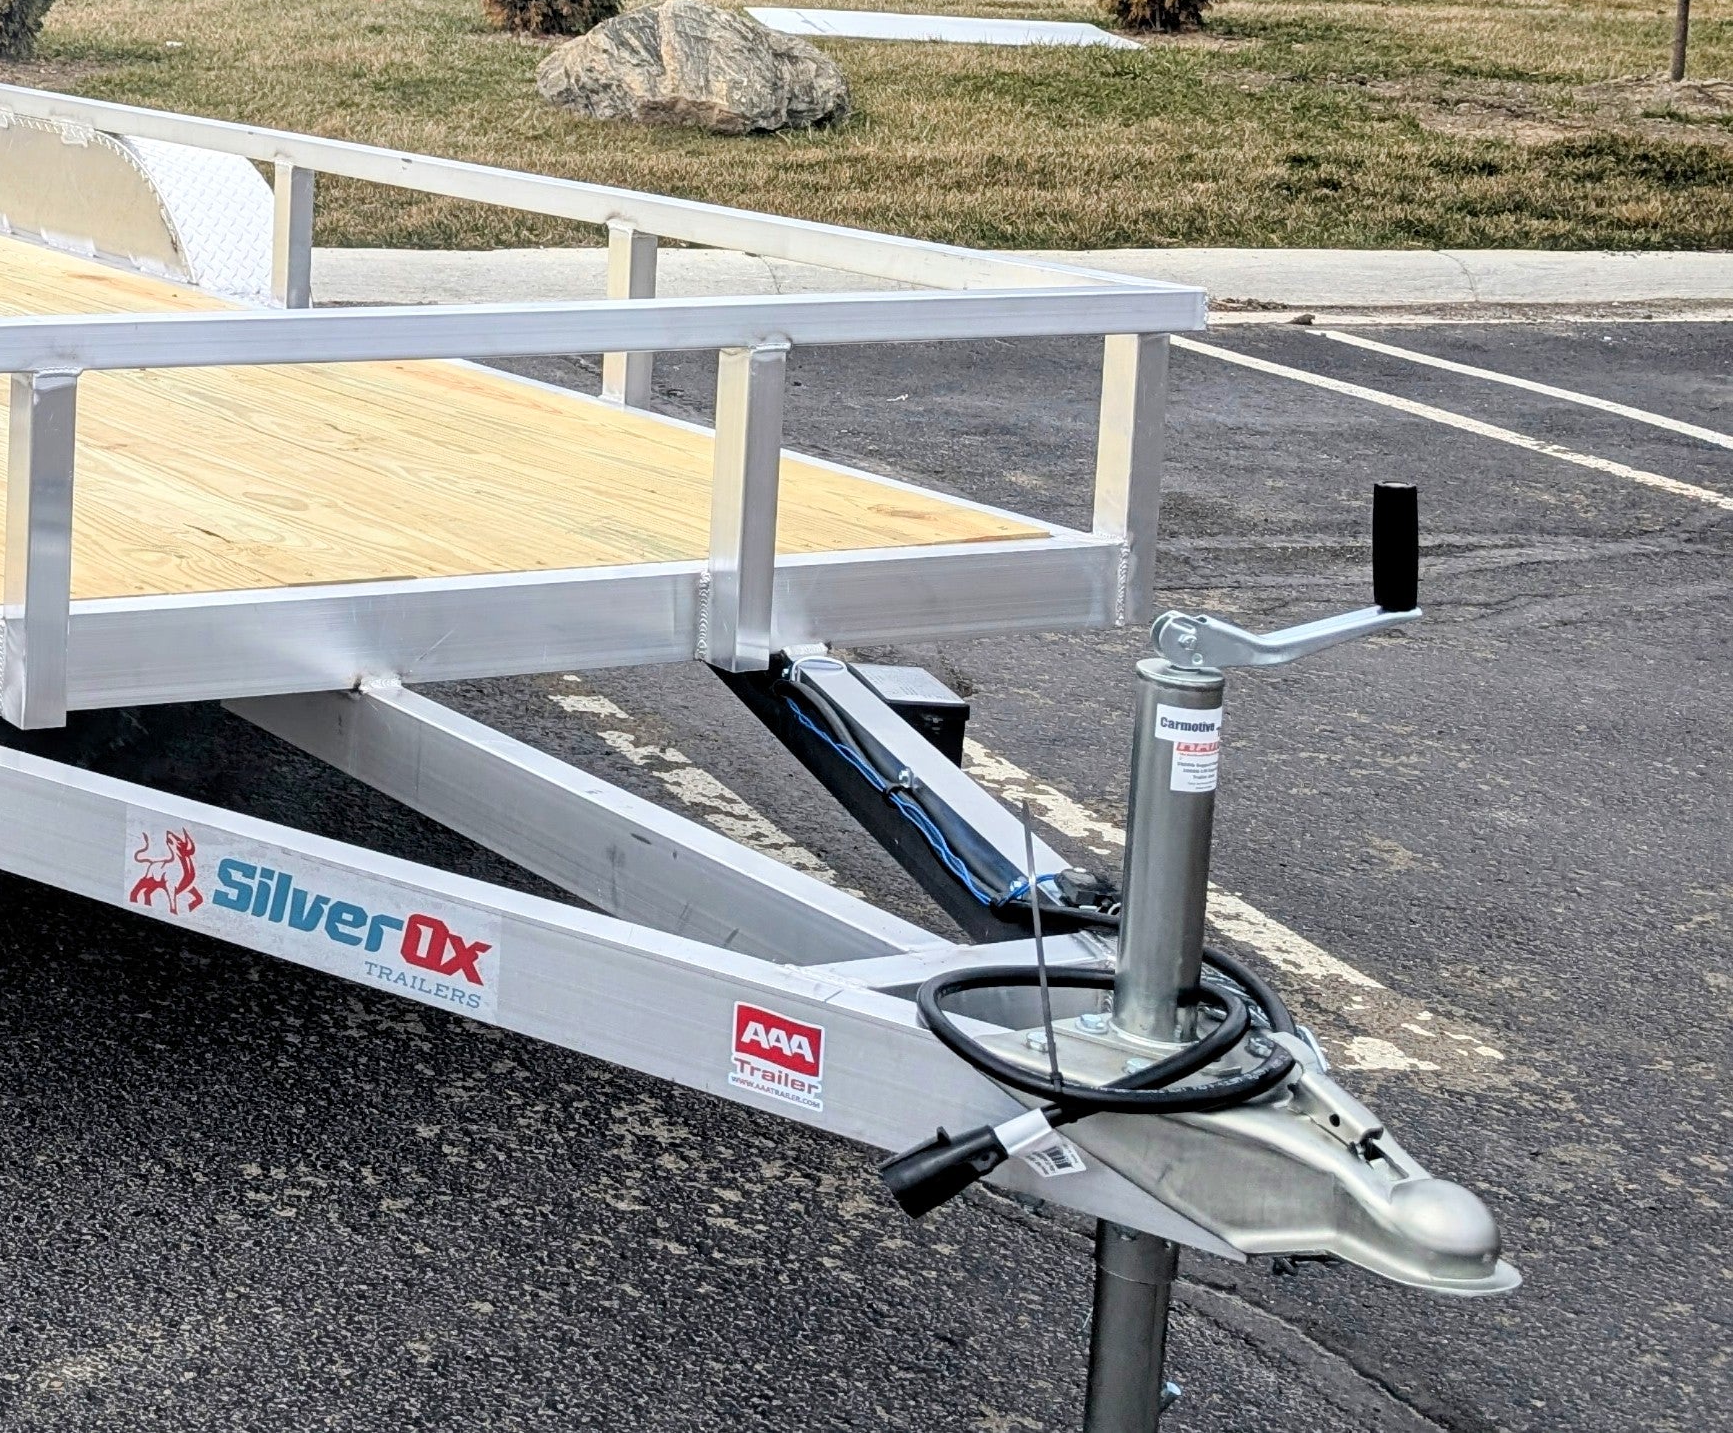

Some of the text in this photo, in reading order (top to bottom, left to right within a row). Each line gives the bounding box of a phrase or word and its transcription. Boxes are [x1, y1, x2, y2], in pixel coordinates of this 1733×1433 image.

[1160, 717, 1215, 733] Carmotive
[212, 858, 493, 986] SilverOx
[364, 961, 481, 1009] TRAILERS
[741, 1021, 814, 1064] AAA
[731, 1076, 820, 1109] WWW.AAATRAILER.COM
[734, 1057, 819, 1094] Trailer
